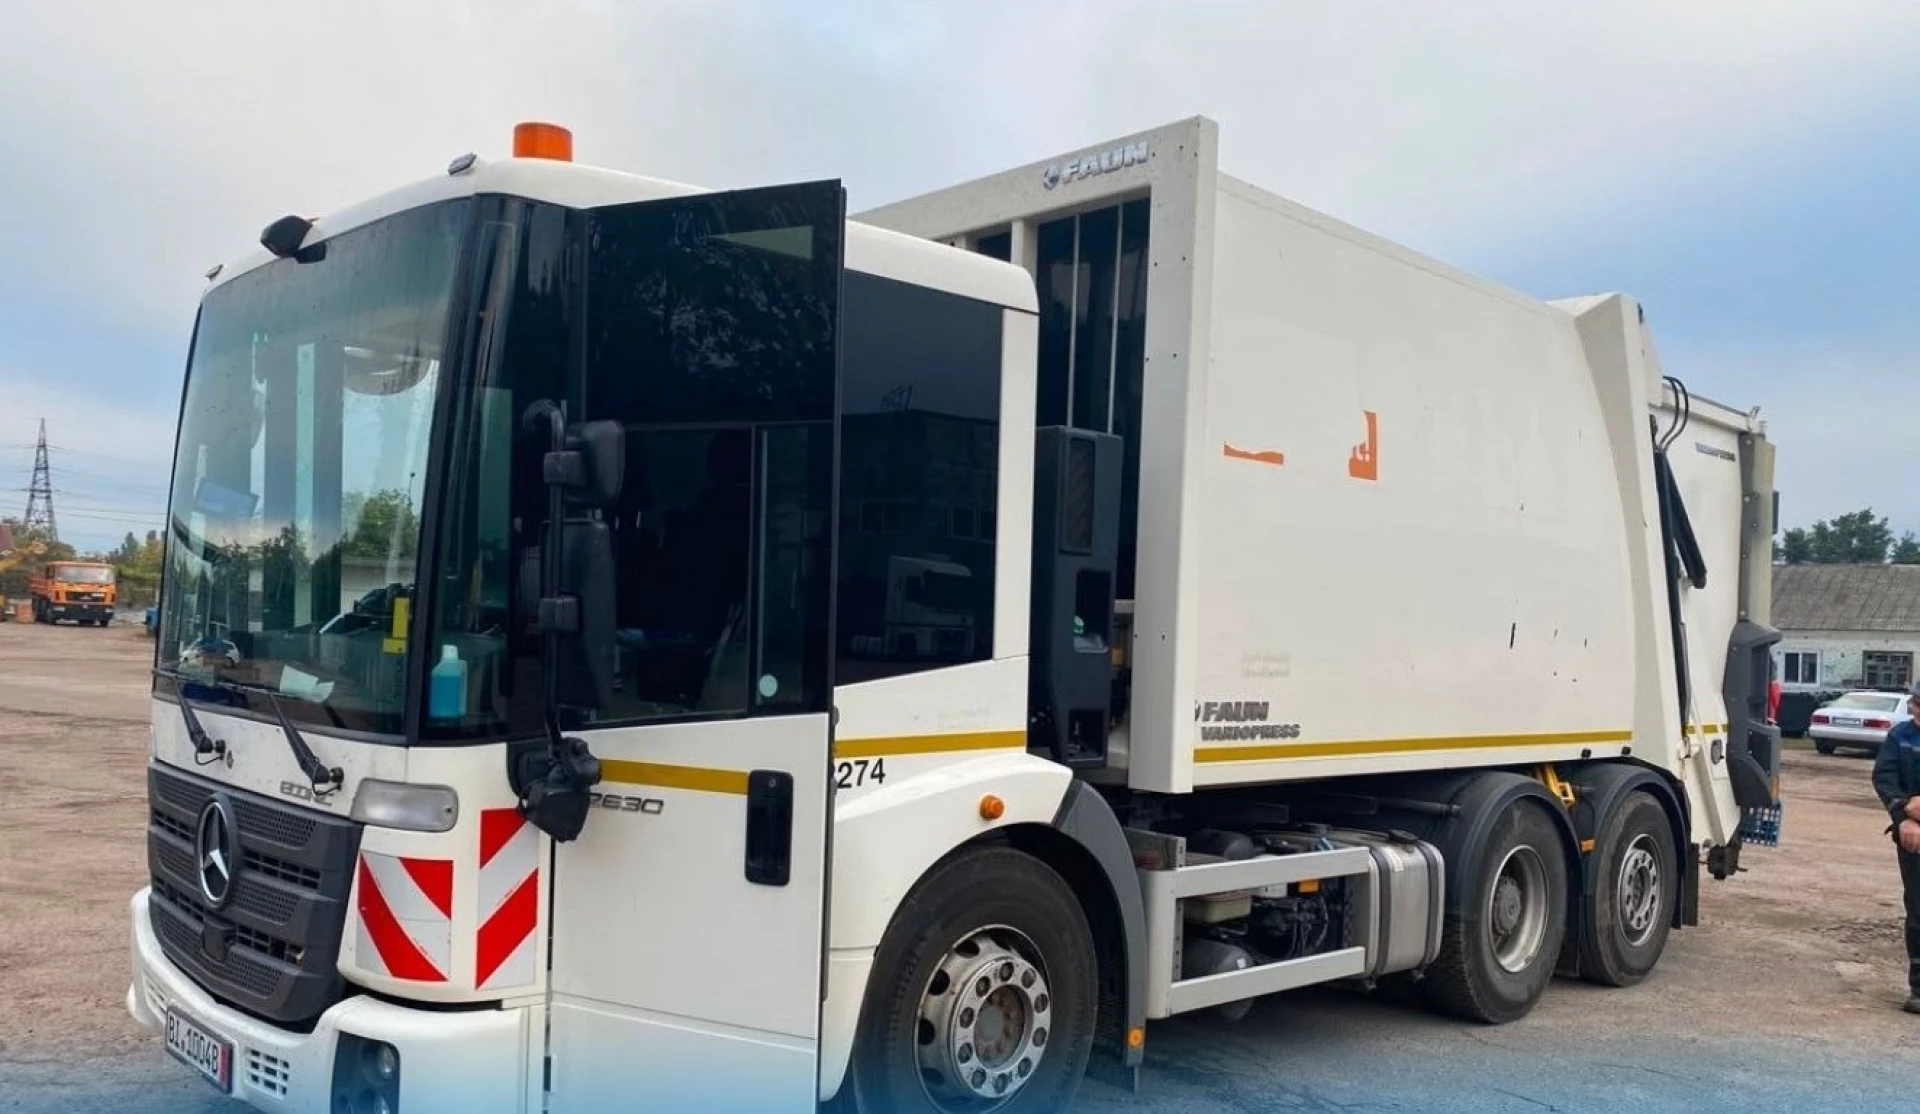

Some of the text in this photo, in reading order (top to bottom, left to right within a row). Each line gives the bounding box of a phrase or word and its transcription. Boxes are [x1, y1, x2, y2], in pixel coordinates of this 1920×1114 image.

[1061, 140, 1149, 184] FAUN
[1201, 700, 1270, 722] FAUN
[1200, 723, 1301, 741] VARIOPRESS
